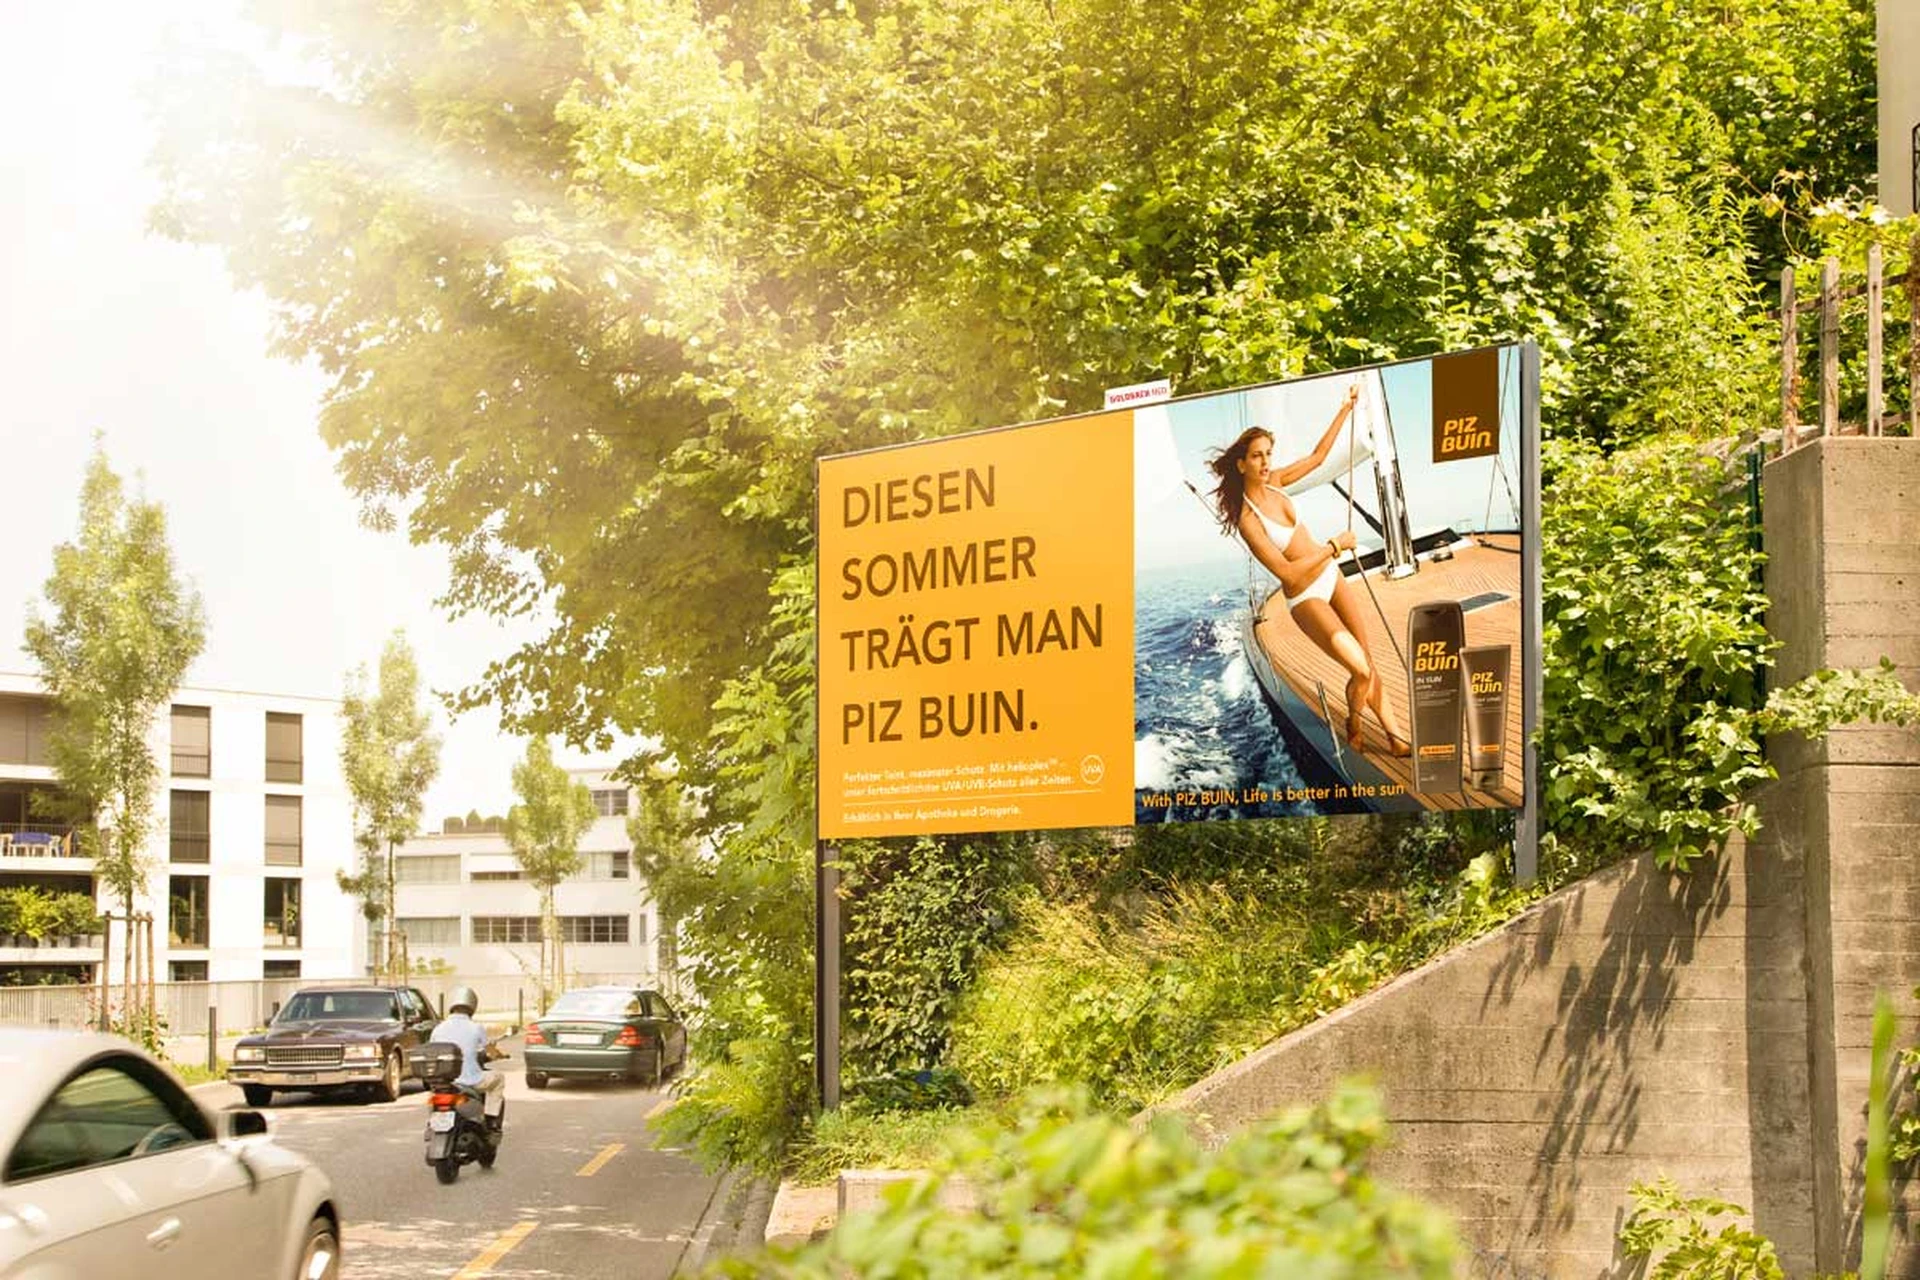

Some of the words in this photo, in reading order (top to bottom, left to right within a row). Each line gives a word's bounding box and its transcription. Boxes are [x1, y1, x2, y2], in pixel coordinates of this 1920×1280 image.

[1444, 416, 1478, 436] PIZ
[843, 465, 996, 528] DIESEN
[842, 535, 1037, 600] SOMMER
[840, 614, 980, 672] TRÄGT
[997, 603, 1103, 658] MAN
[1417, 641, 1447, 657] PIZ
[1472, 672, 1494, 684] PIZ
[843, 699, 903, 745] PIZ
[920, 689, 1038, 739] BUIN.
[1083, 763, 1104, 775] UVA
[1141, 793, 1171, 808] With
[1176, 792, 1197, 806] PIZ
[1201, 789, 1239, 806] BUIN,
[1243, 788, 1268, 804] Life
[1272, 786, 1283, 802] is
[1287, 784, 1329, 802] better
[1335, 783, 1348, 799] in
[1352, 782, 1375, 798] the
[1379, 781, 1406, 797] sun
[960, 806, 978, 817] und
